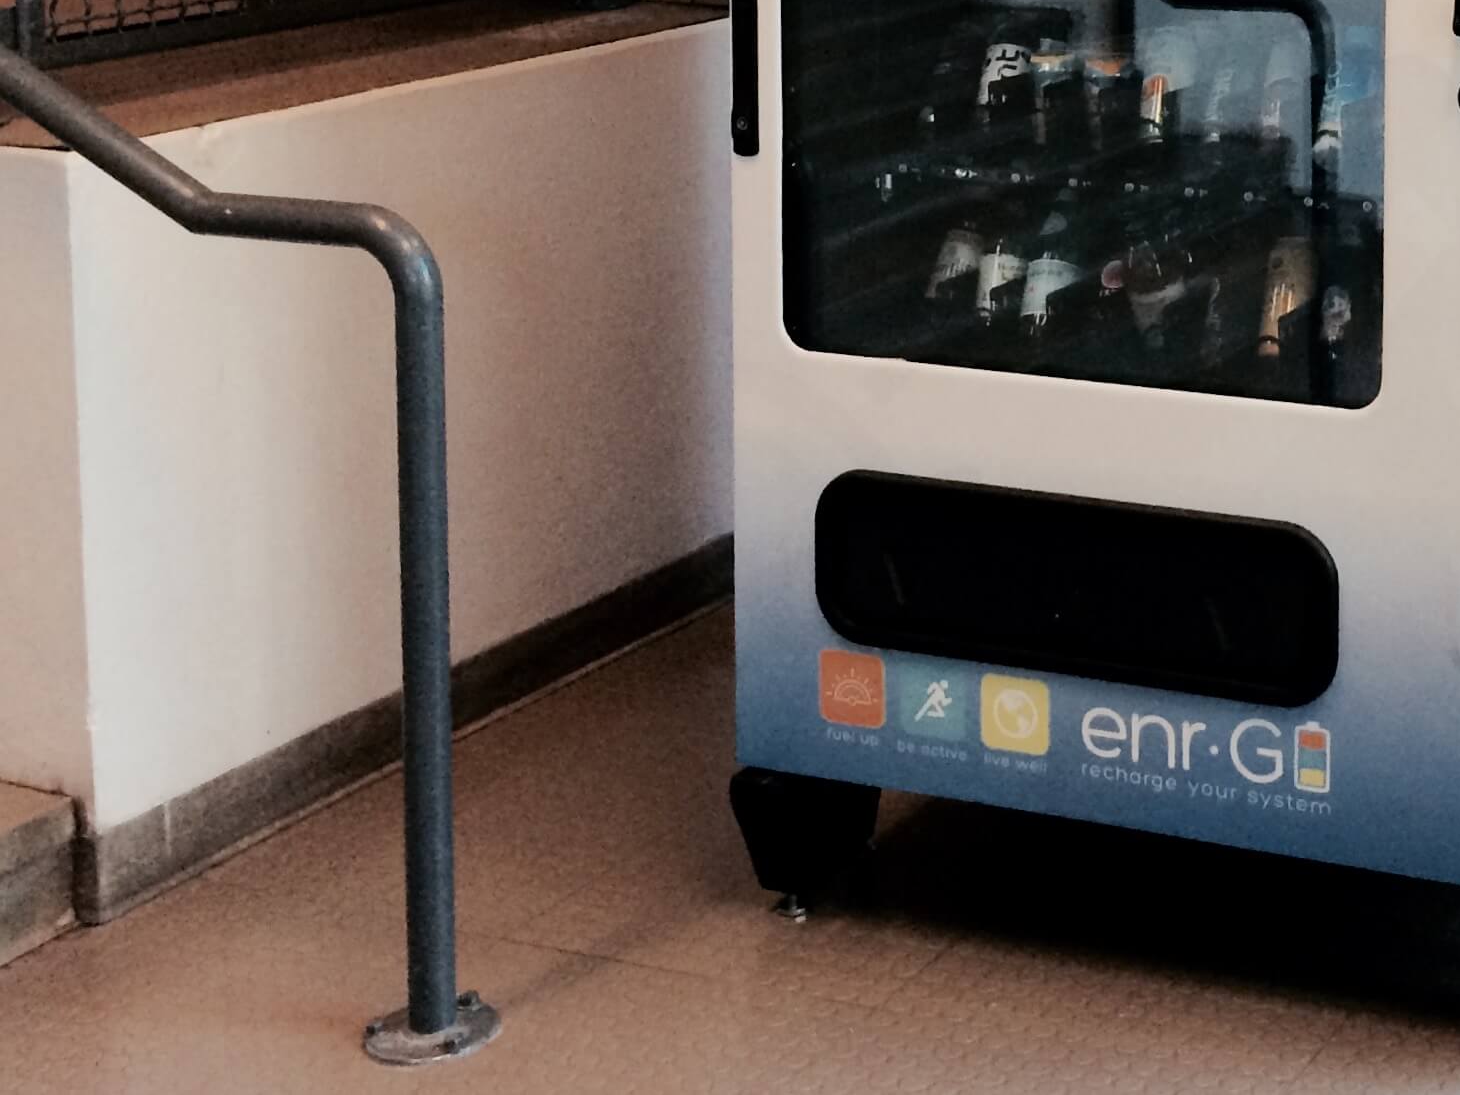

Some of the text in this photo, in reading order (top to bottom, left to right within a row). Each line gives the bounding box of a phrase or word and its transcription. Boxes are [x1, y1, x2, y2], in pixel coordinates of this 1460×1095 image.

[921, 745, 968, 762] active
[1081, 761, 1332, 816] recharge your system
